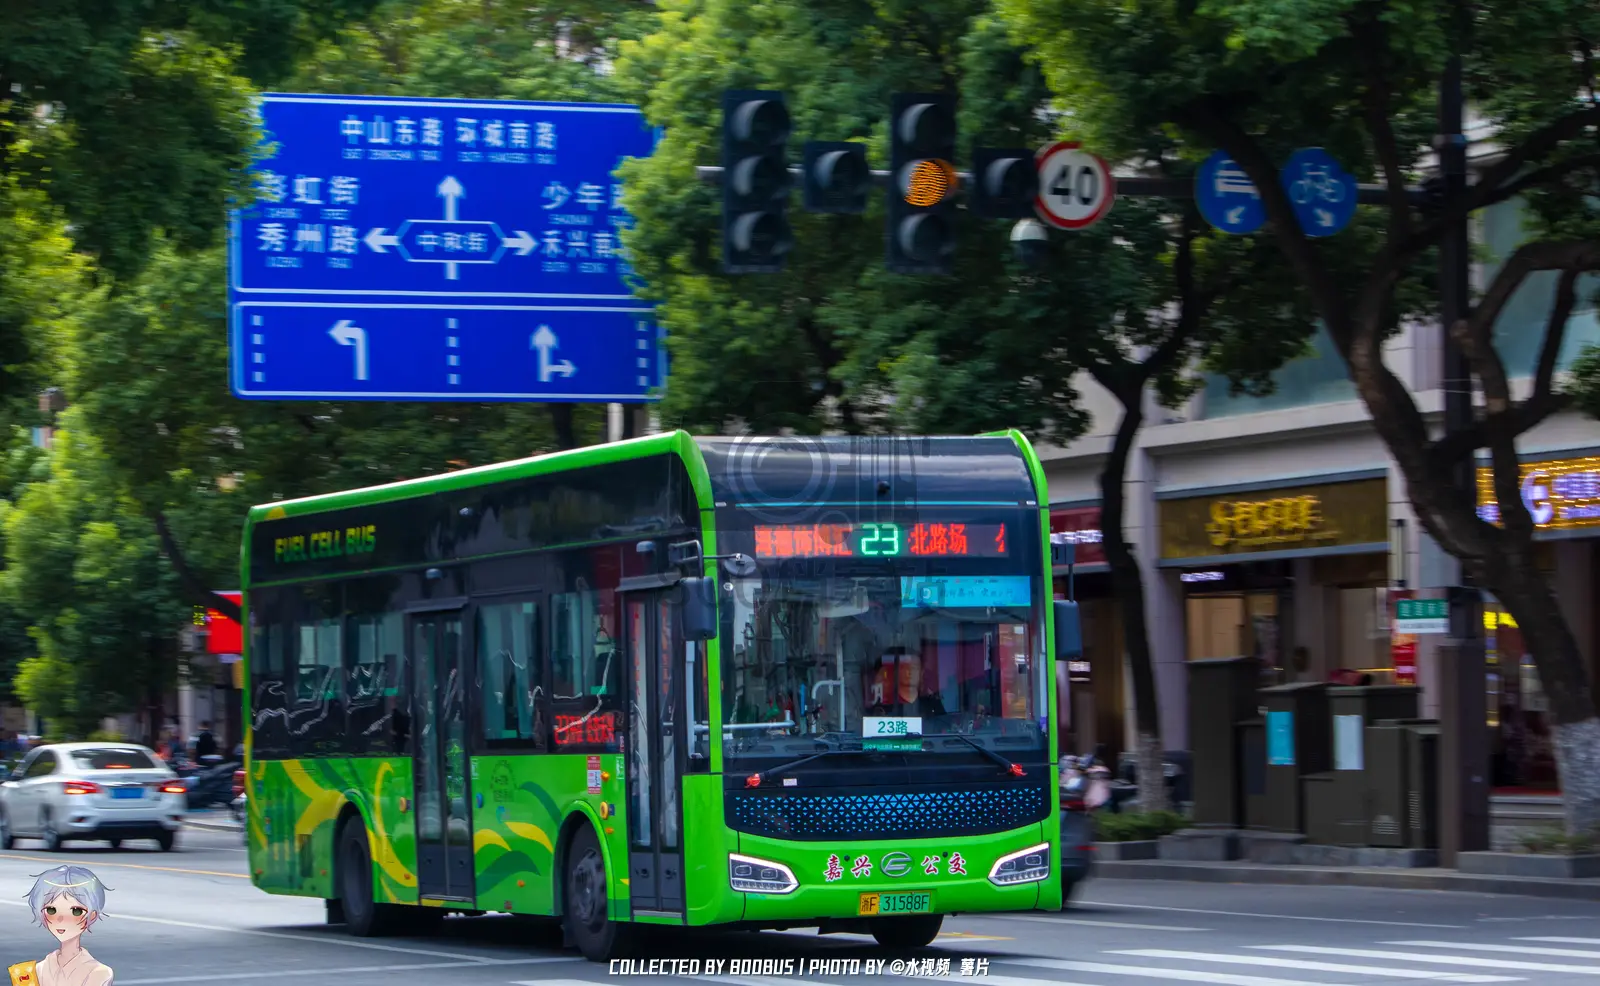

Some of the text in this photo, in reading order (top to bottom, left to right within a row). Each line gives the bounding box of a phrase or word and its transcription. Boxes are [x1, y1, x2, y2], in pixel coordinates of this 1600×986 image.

[340, 115, 557, 150] 中山东路 环城南路
[1048, 165, 1099, 206] 40
[257, 223, 359, 254] 秀州路
[275, 524, 376, 564] FUEL CELL BUS
[861, 524, 899, 555] 23
[877, 721, 908, 734] 23路
[823, 851, 967, 882] 嘉兴 公交
[883, 894, 929, 911] 31588F
